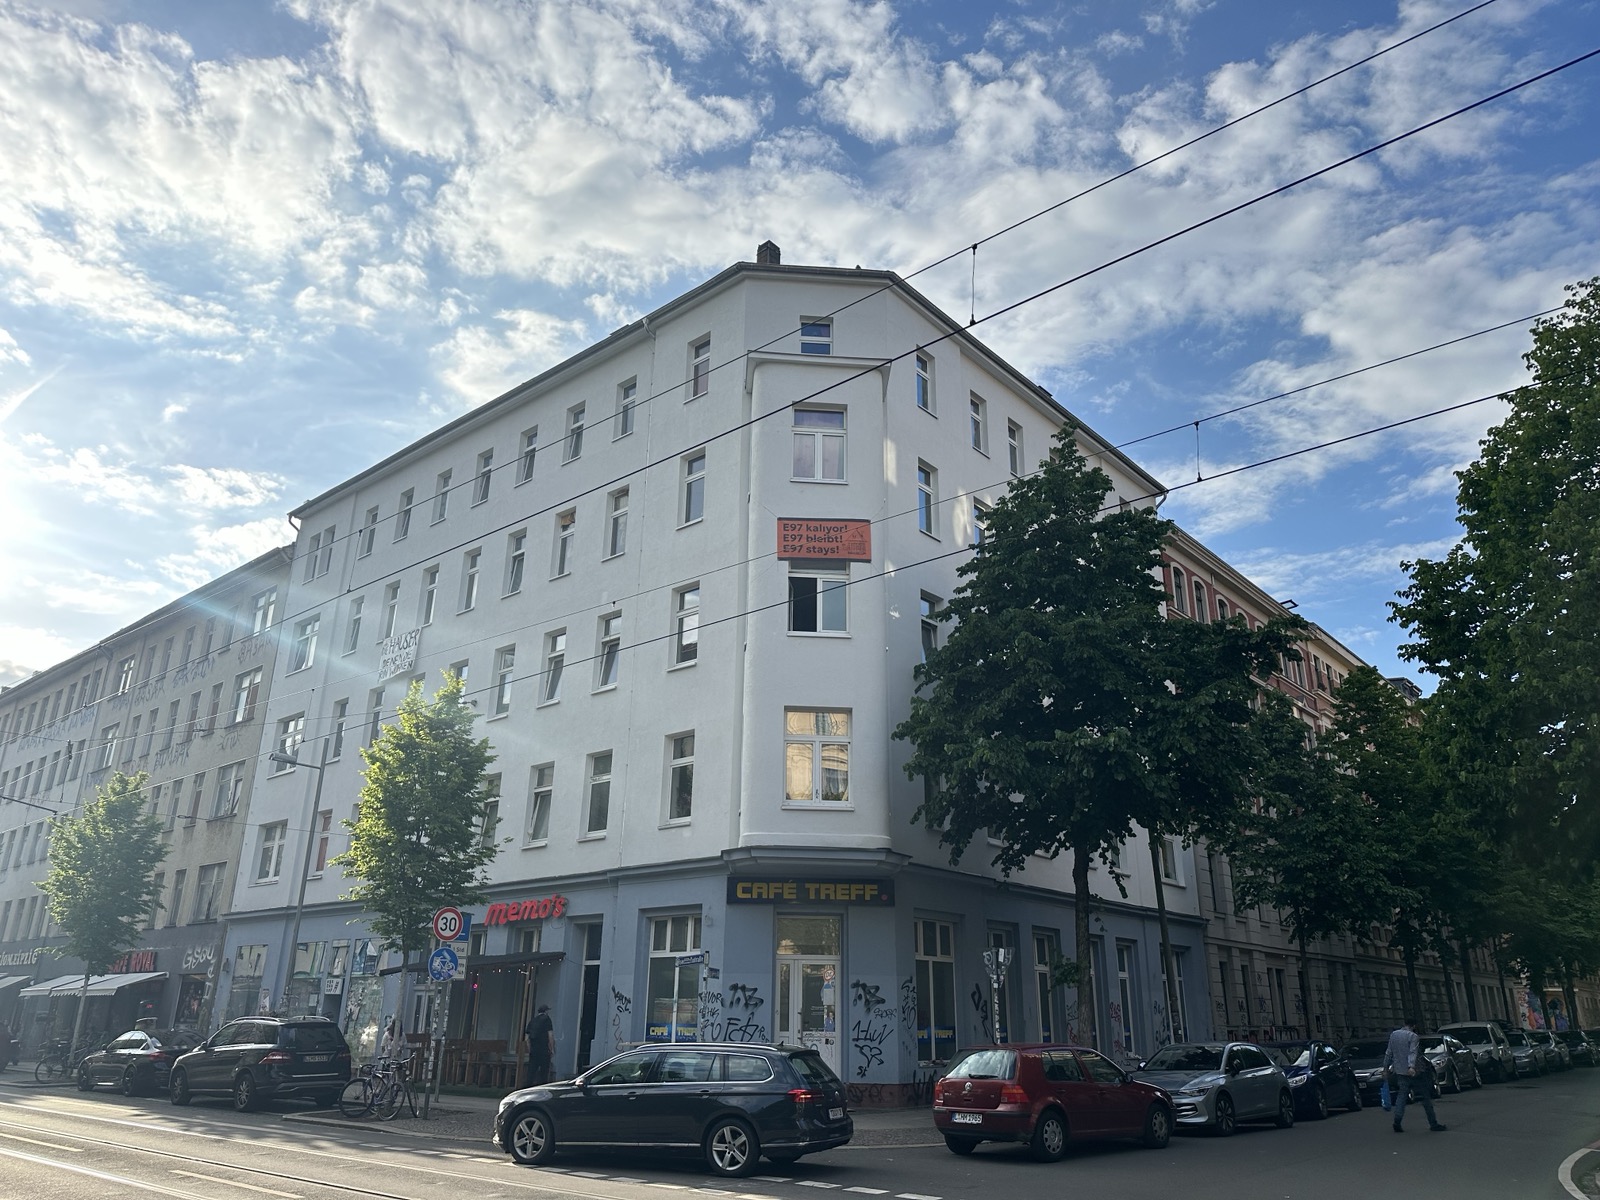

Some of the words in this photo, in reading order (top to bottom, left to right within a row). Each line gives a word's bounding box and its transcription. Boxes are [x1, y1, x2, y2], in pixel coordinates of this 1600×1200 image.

[783, 534, 803, 542] E97
[806, 534, 843, 543] bleibt!
[783, 544, 803, 553] E97
[805, 545, 839, 555] stays!
[737, 880, 797, 899] CAFÉ
[805, 884, 878, 901] TREFF
[484, 892, 565, 926] memo's
[440, 917, 457, 932] 30
[934, 1029, 953, 1039] TREFF
